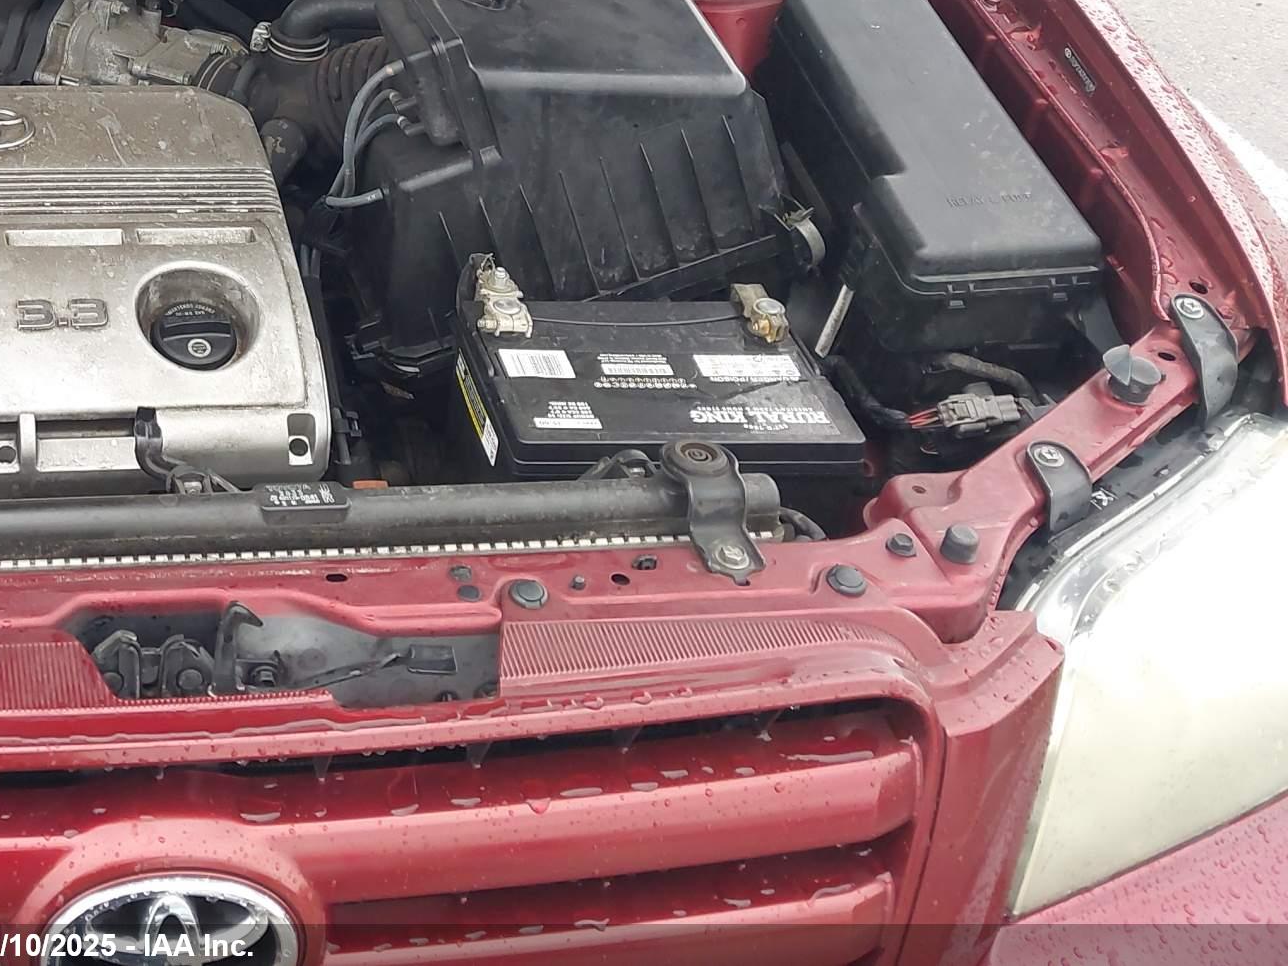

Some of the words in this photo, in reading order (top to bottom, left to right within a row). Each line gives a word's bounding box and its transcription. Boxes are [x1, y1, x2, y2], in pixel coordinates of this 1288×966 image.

[17, 298, 109, 331] 3.3
[689, 410, 747, 423] KING
[748, 411, 830, 424] RURAL
